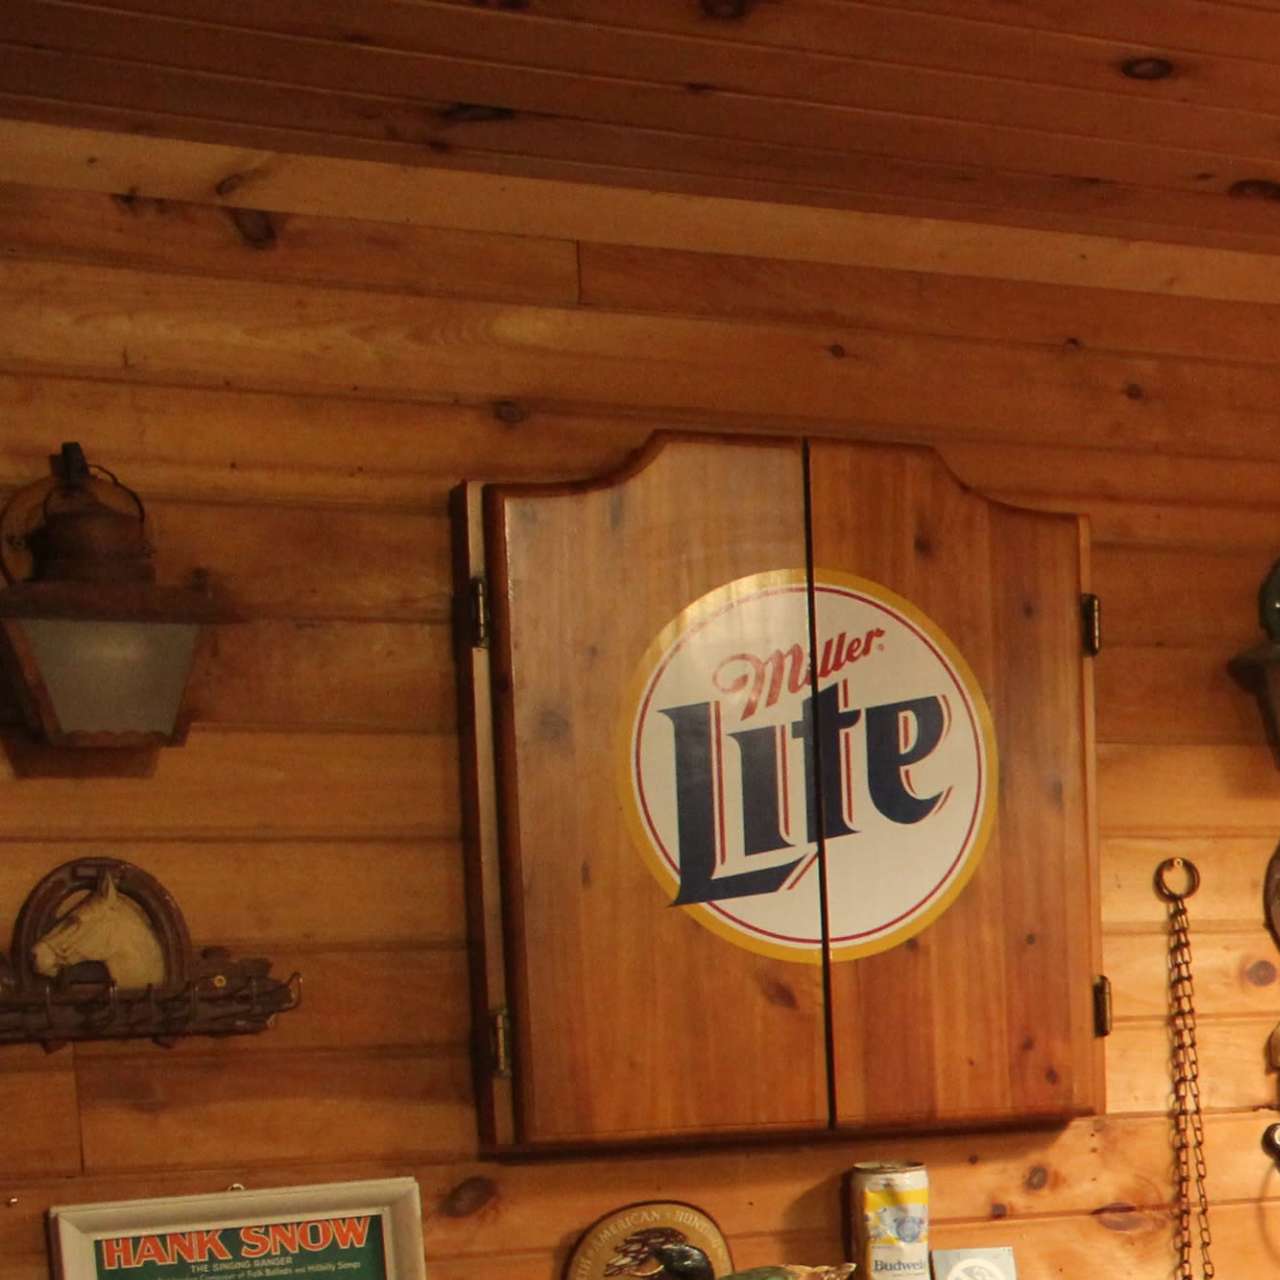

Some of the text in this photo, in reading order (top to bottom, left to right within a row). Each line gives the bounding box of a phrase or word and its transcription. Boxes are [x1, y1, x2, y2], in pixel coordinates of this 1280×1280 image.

[657, 680, 954, 908] Lite
[103, 1216, 370, 1270] HANK SNOW
[593, 1210, 661, 1254] AMERICAN
[191, 1264, 209, 1273] THE
